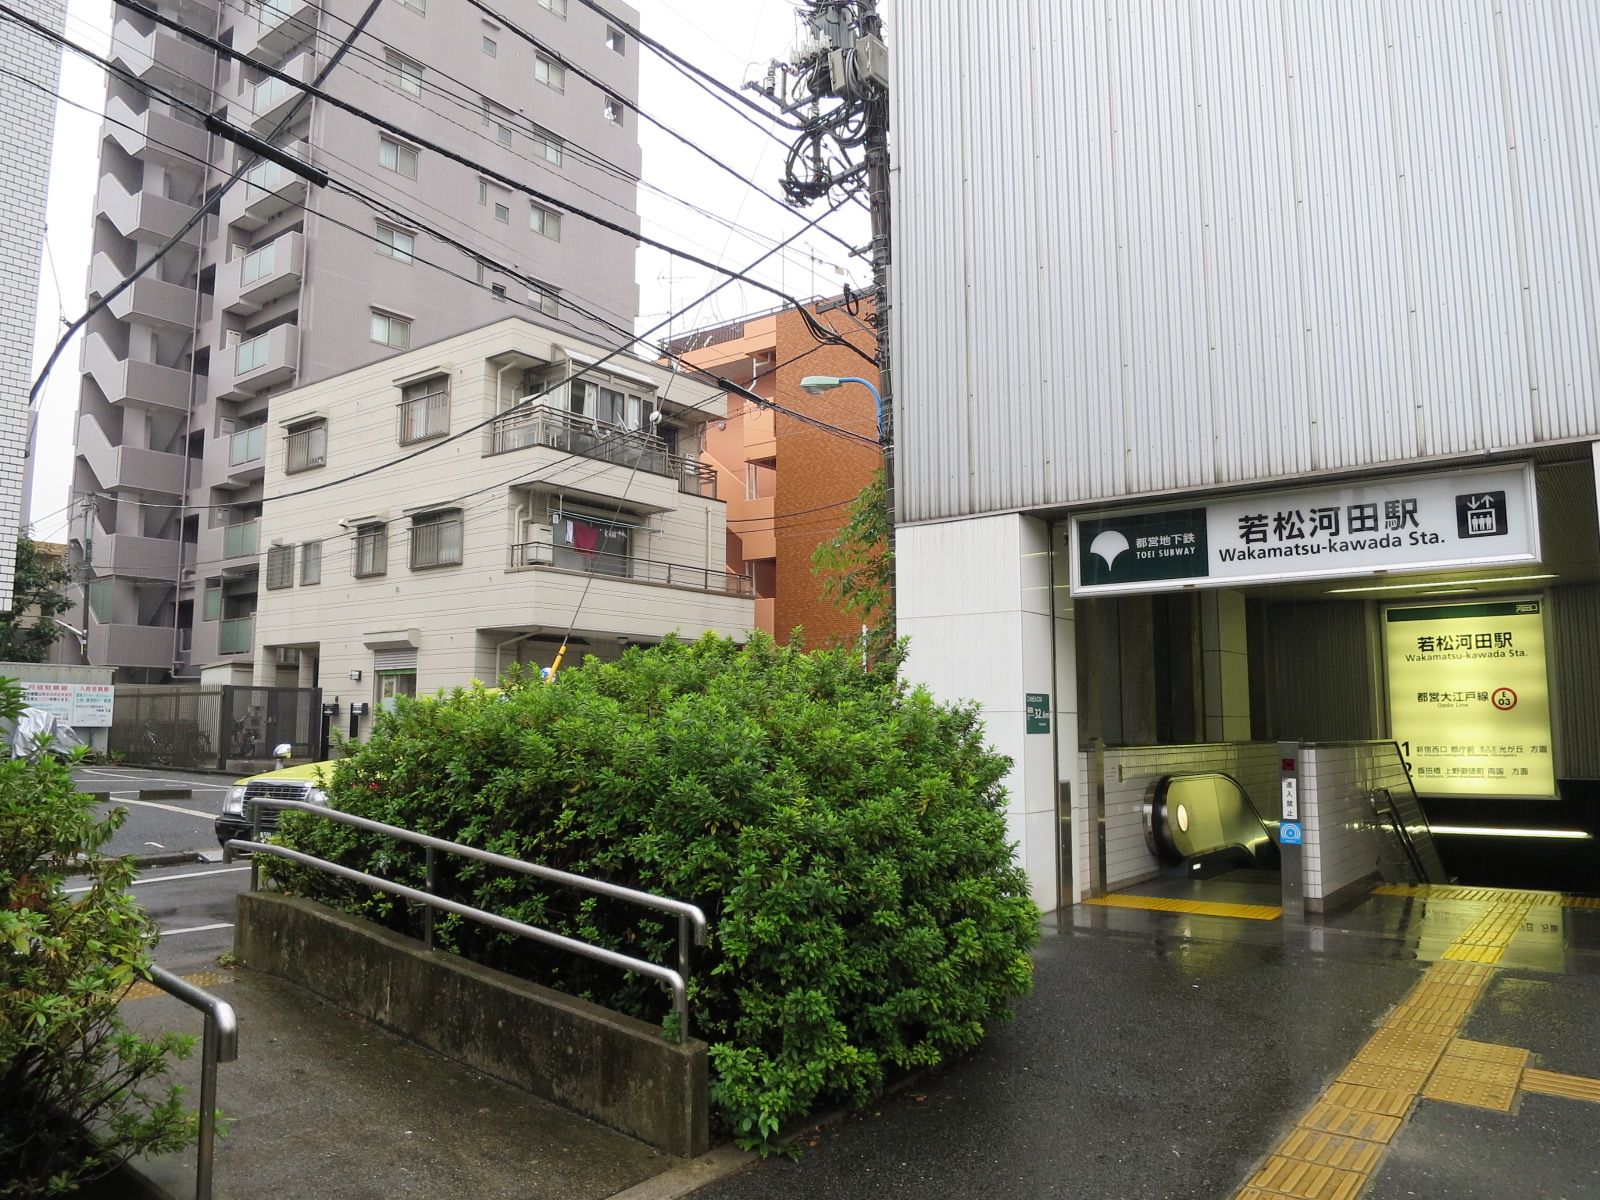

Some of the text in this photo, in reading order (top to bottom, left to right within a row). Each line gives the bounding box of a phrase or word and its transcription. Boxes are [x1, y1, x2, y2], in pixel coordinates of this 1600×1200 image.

[1238, 498, 1419, 545] 若松河田駅
[1135, 532, 1195, 549] 都営地下鉄
[1219, 531, 1446, 563] Wakamatsu-kawada Sta.
[1136, 547, 1195, 560] TOEI SUBWAY
[1417, 632, 1513, 652] 若松河田駅
[1405, 649, 1529, 662] Wakamatsu-kawada Sta.
[1417, 691, 1489, 702] 都営大江戸線
[1498, 698, 1511, 706] 03
[1401, 741, 1410, 757] 1
